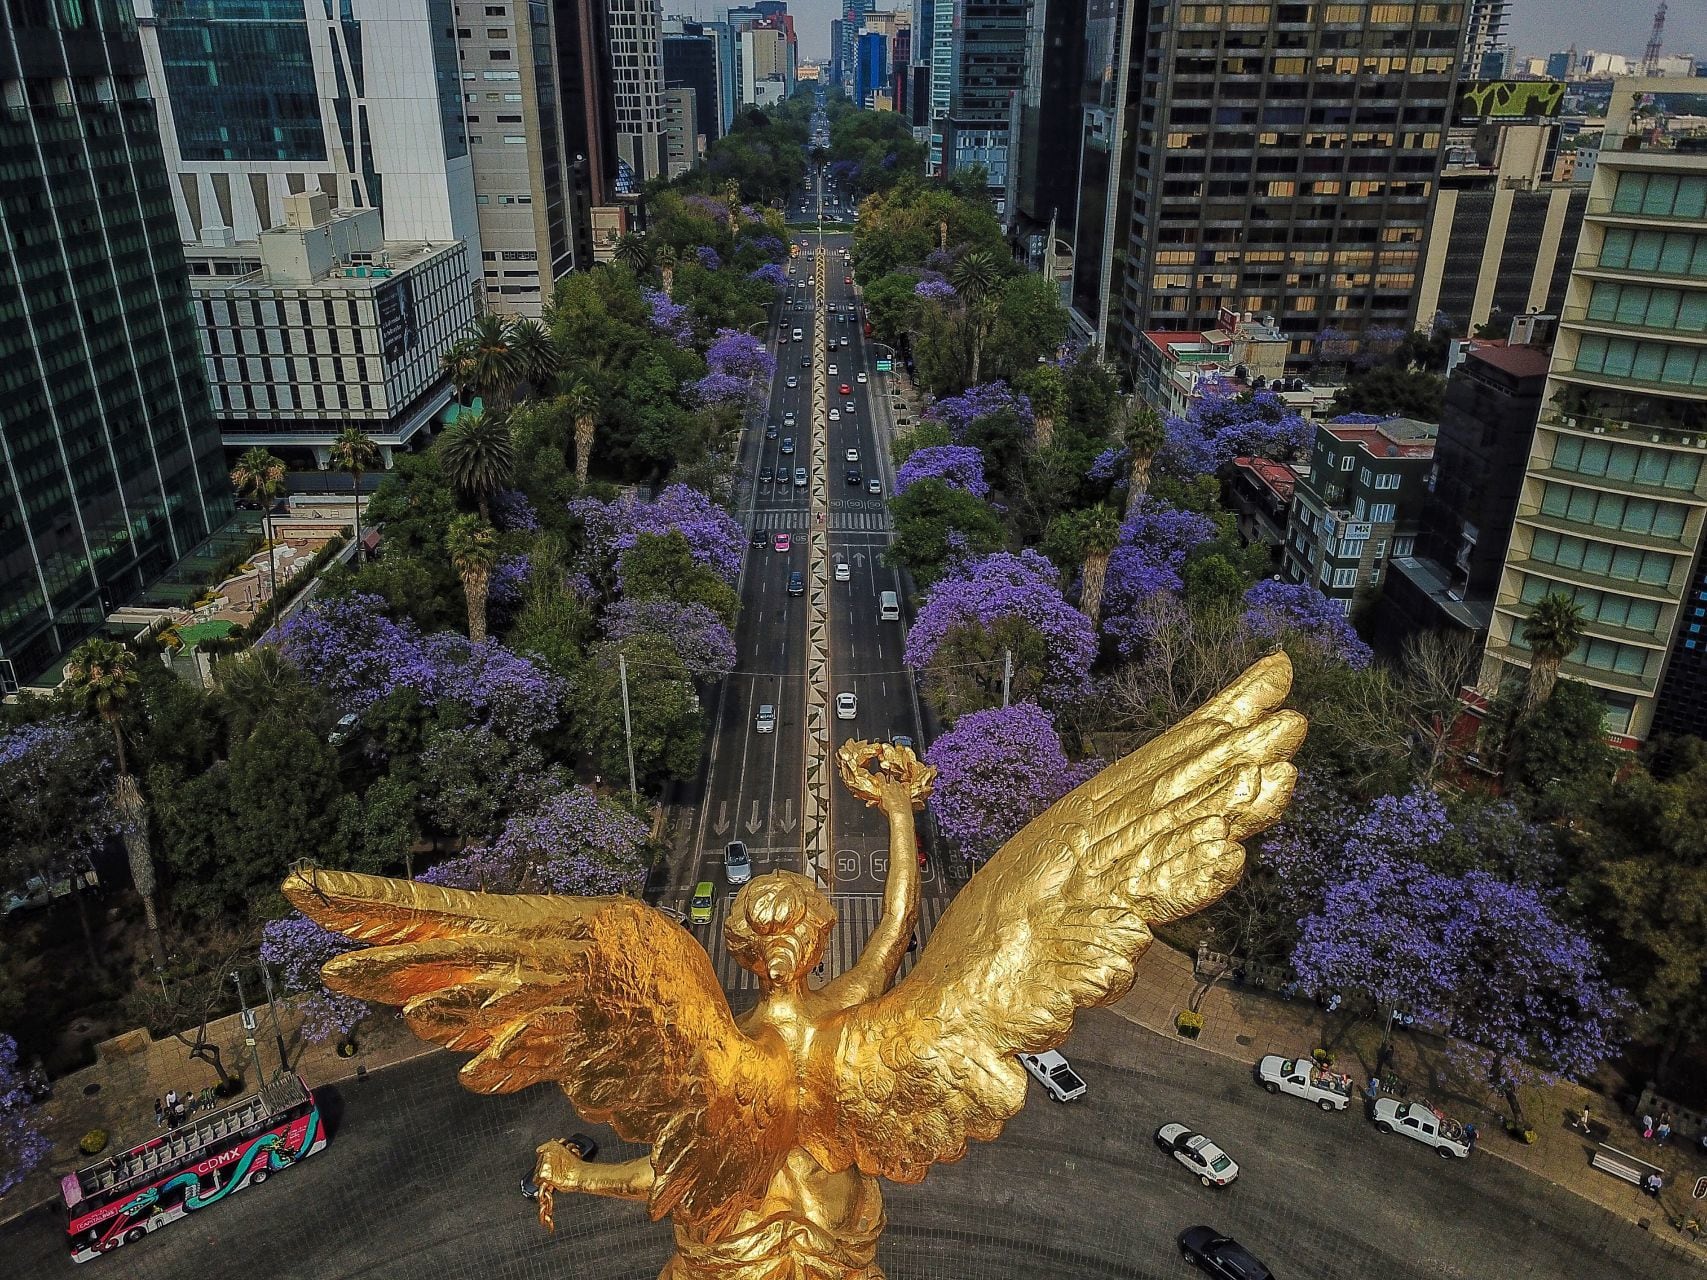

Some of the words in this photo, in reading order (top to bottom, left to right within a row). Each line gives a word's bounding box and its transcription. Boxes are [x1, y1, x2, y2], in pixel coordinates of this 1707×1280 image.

[1354, 525, 1369, 533] MX
[838, 858, 856, 872] 50
[198, 1147, 241, 1173] CDMX
